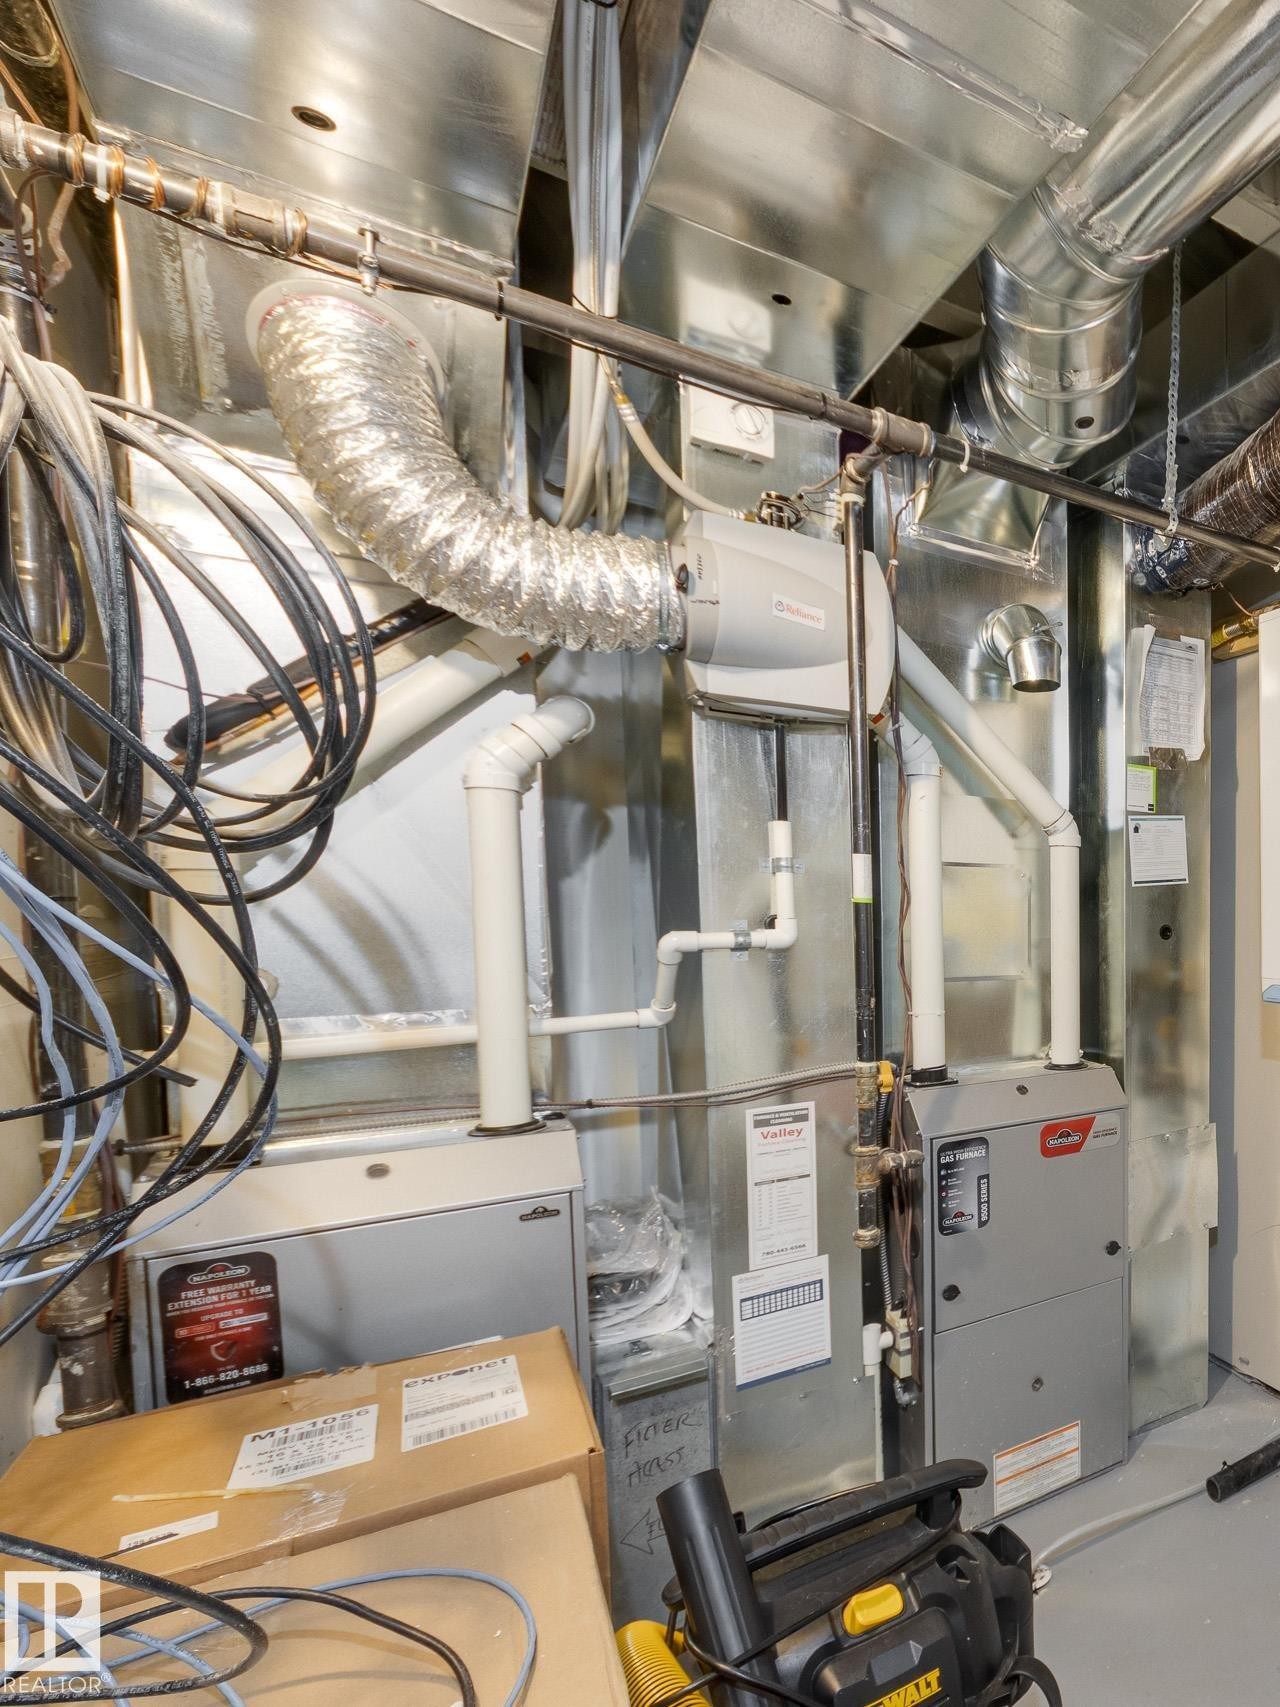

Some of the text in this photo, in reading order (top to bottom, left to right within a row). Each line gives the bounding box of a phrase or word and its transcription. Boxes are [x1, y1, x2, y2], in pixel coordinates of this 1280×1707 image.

[786, 604, 822, 624] Reliance
[761, 1128, 803, 1140] Valley
[1048, 1135, 1080, 1146] NAPOLEON
[940, 1149, 986, 1163] GAS FURNACE
[945, 1214, 973, 1225] NAPOLEON
[191, 1267, 246, 1282] NAPOLEON
[181, 1280, 256, 1299] FREE WARRANTY
[167, 1294, 219, 1311] EXTENSION
[220, 1290, 239, 1300] FOR
[249, 1285, 272, 1295] YEAR
[250, 1408, 371, 1443] M1-1056
